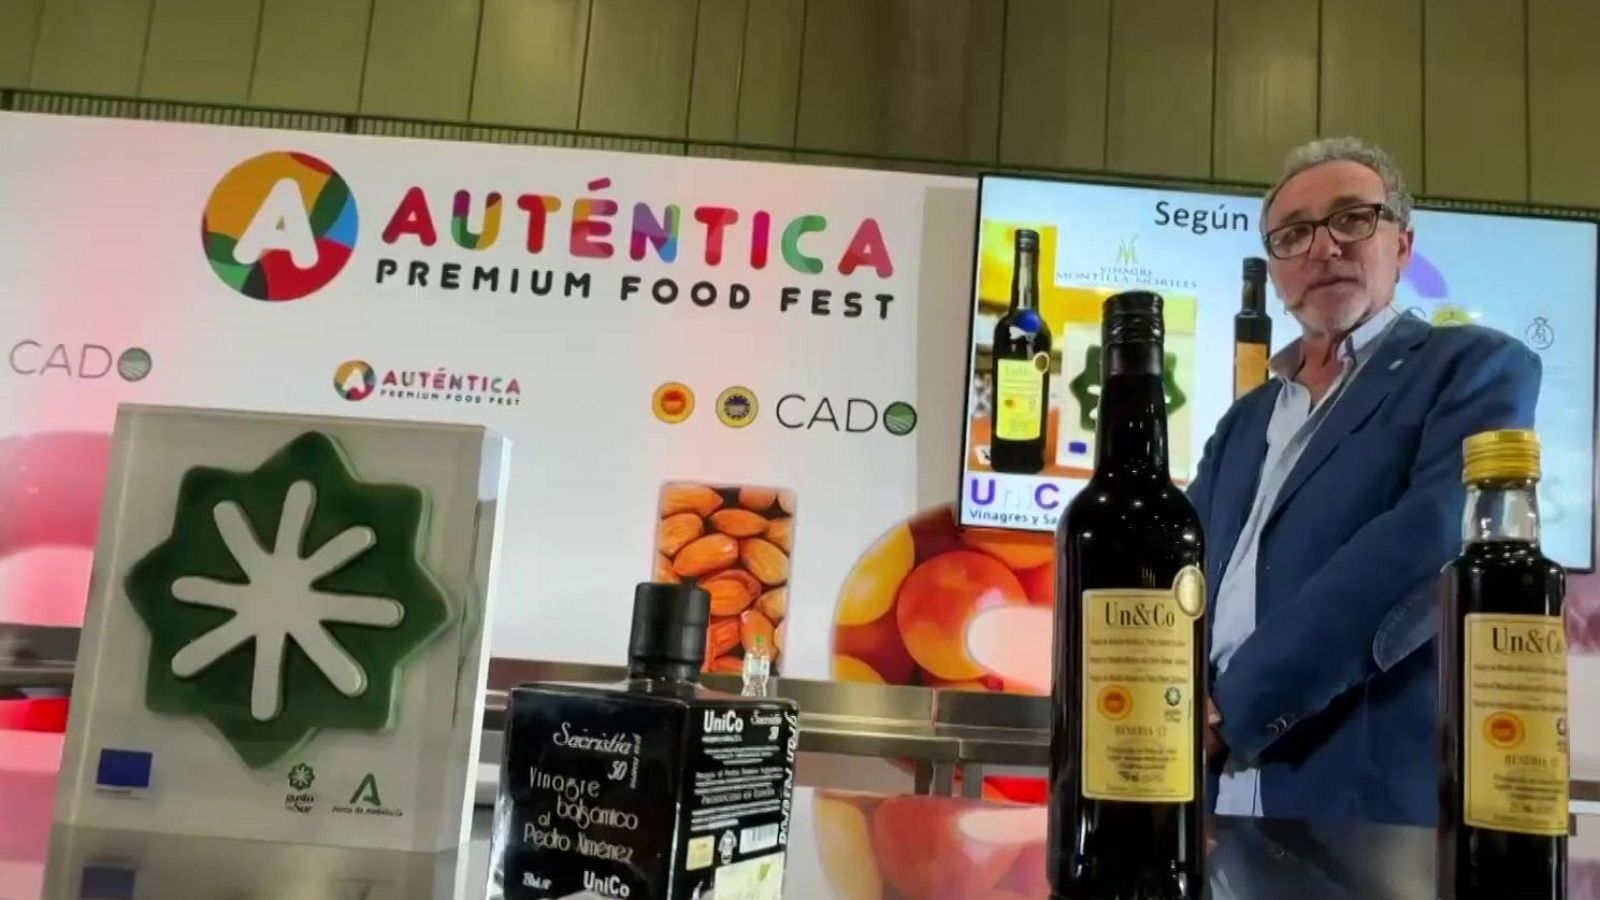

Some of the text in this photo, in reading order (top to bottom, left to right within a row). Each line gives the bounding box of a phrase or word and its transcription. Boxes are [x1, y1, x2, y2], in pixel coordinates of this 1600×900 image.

[381, 176, 895, 279] AUTÉNTICA
[1153, 200, 1249, 234] Según
[376, 258, 896, 320] PREMIUM FOOD FEST
[382, 367, 520, 394] AUTÉNTICA
[380, 389, 520, 406] PREMIUM FOOD FEST
[969, 509, 1027, 523] Vinagres
[1032, 515, 1039, 525] y
[1105, 601, 1175, 628] Un&Co
[703, 709, 744, 733] UniCo
[552, 721, 632, 755] Sacristía
[530, 766, 601, 800] Vinagre
[523, 822, 571, 851] Pedro
[538, 811, 552, 836] al
[583, 870, 630, 897] UniCo
